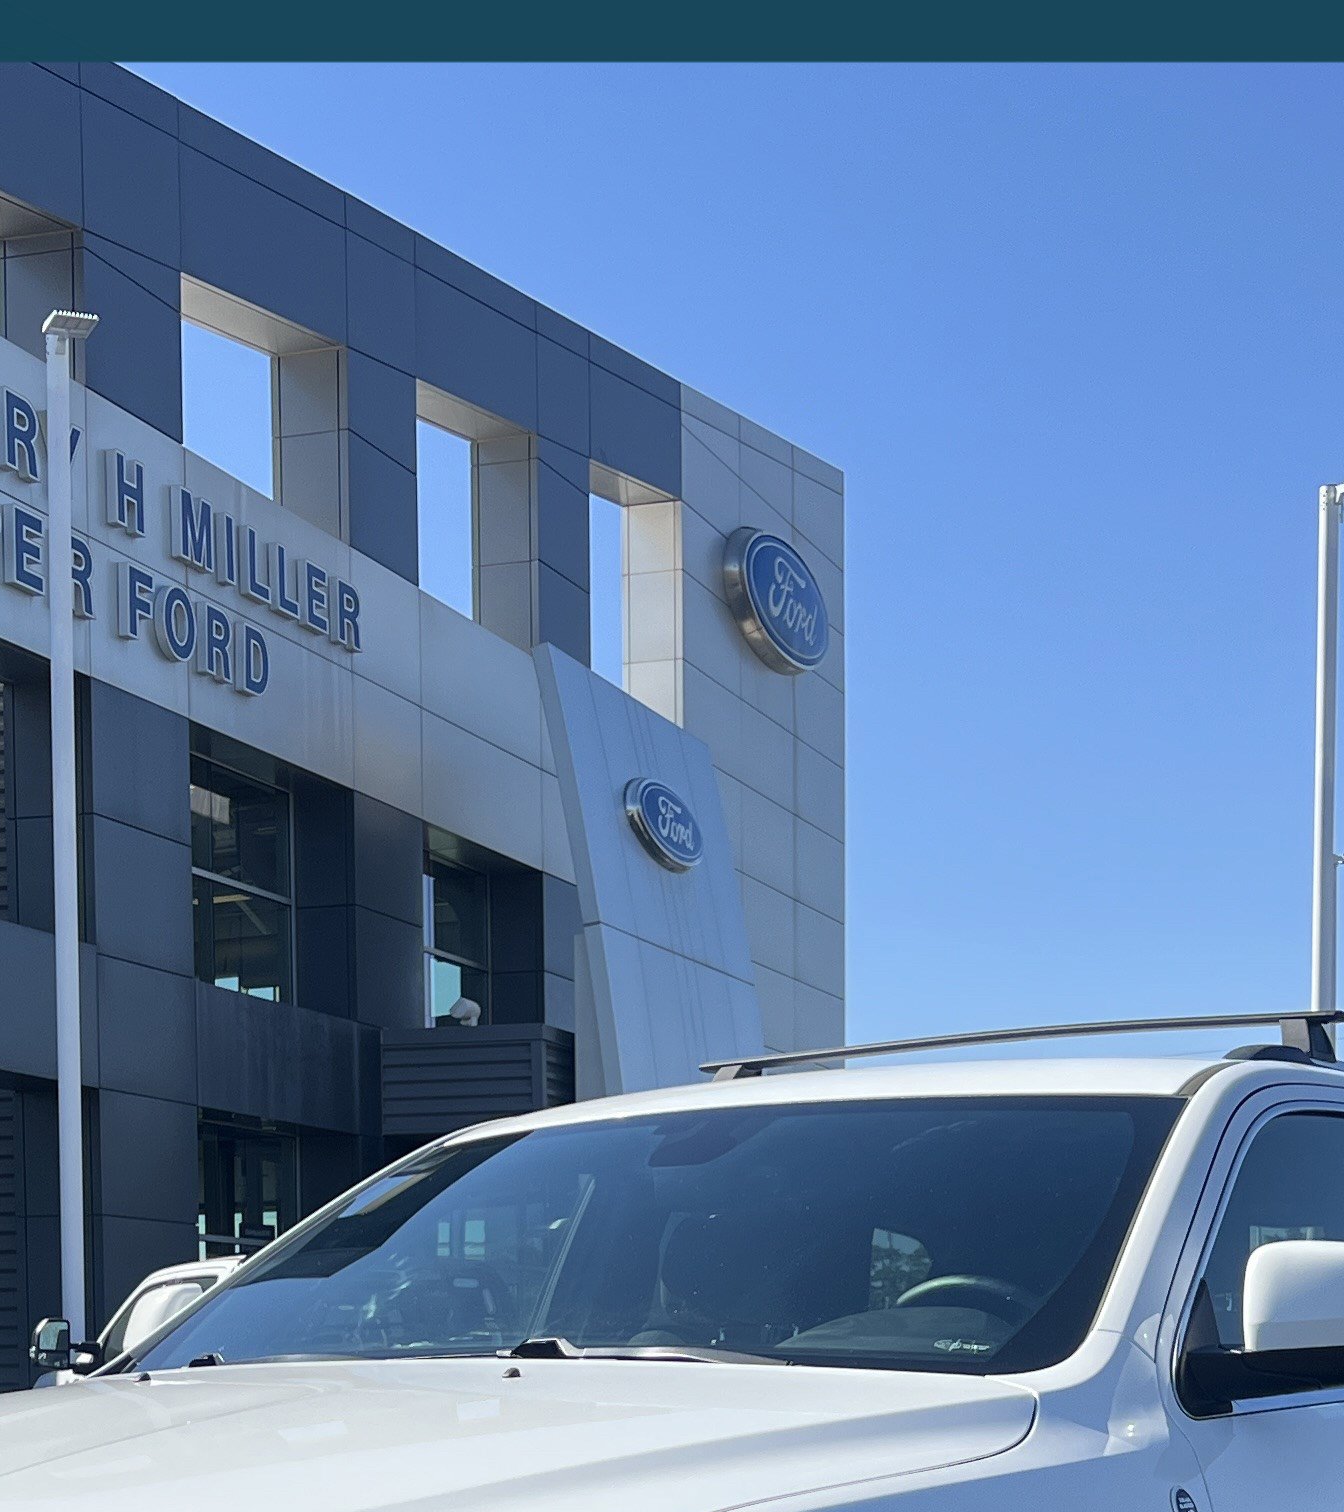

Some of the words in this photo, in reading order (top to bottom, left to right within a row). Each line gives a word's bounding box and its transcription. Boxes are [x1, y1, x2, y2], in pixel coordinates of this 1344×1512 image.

[105, 448, 145, 538] H
[171, 485, 362, 653] MILLER
[768, 556, 819, 647] Ford
[118, 560, 270, 697] FORD
[657, 795, 694, 851] Ford
